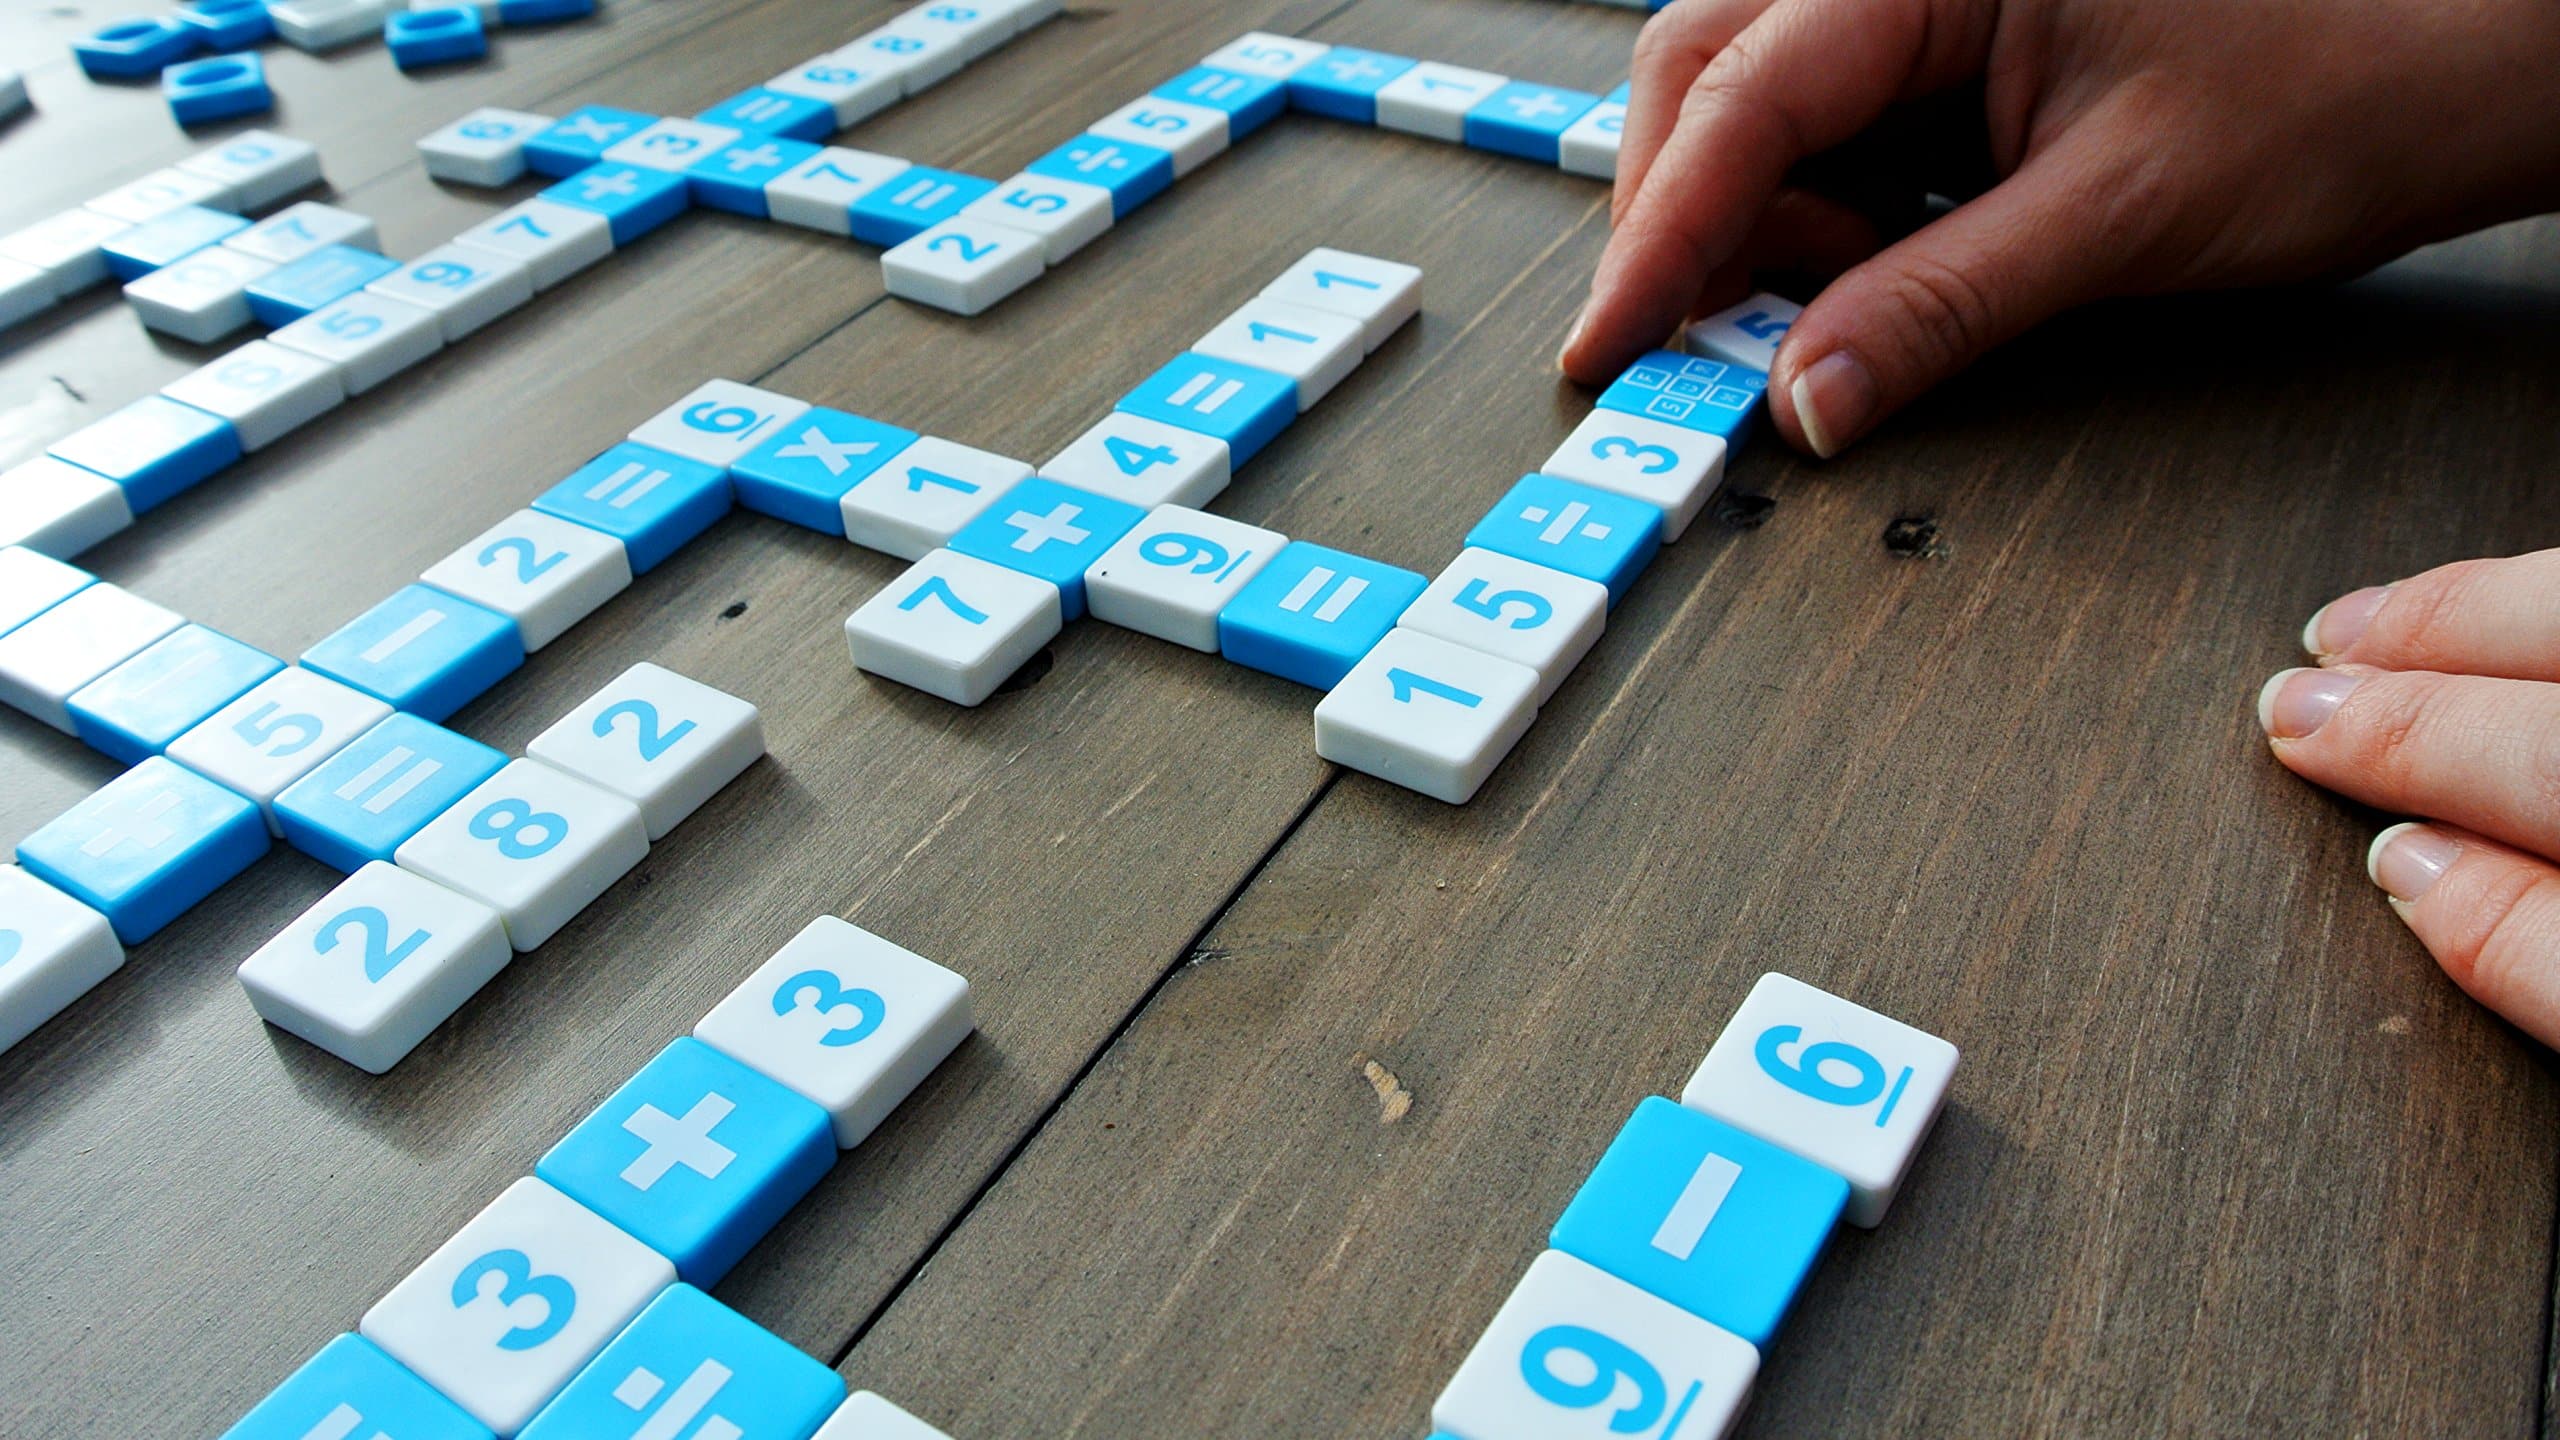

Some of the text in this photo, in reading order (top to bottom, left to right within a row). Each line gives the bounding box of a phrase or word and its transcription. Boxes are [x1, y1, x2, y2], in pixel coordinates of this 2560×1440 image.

[1240, 44, 1296, 65] 5
[1420, 76, 1477, 94] 1
[643, 132, 702, 156] 3
[803, 161, 866, 185] 7
[926, 232, 999, 263] 2
[1004, 187, 1070, 216] 5
[1124, 109, 1190, 133] 5
[318, 308, 384, 342] 5
[411, 259, 490, 291] 9
[493, 214, 552, 239] 7
[681, 399, 777, 439] 6
[905, 465, 982, 496] 1
[1137, 531, 1254, 585] 9
[898, 575, 990, 624] 7
[1102, 433, 1181, 479] 4
[1247, 320, 1319, 347] 1
[1312, 269, 1382, 293] 1
[476, 536, 569, 585] 2
[1385, 666, 1484, 708] 1
[1451, 577, 1556, 631] 5
[1589, 435, 1680, 475] 3
[231, 701, 324, 758] 5
[312, 698, 699, 985] 2 8 2
[451, 1249, 578, 1352] 3
[771, 968, 886, 1047] 3
[1520, 1324, 1702, 1440] 9
[1755, 1024, 1914, 1128] 6
